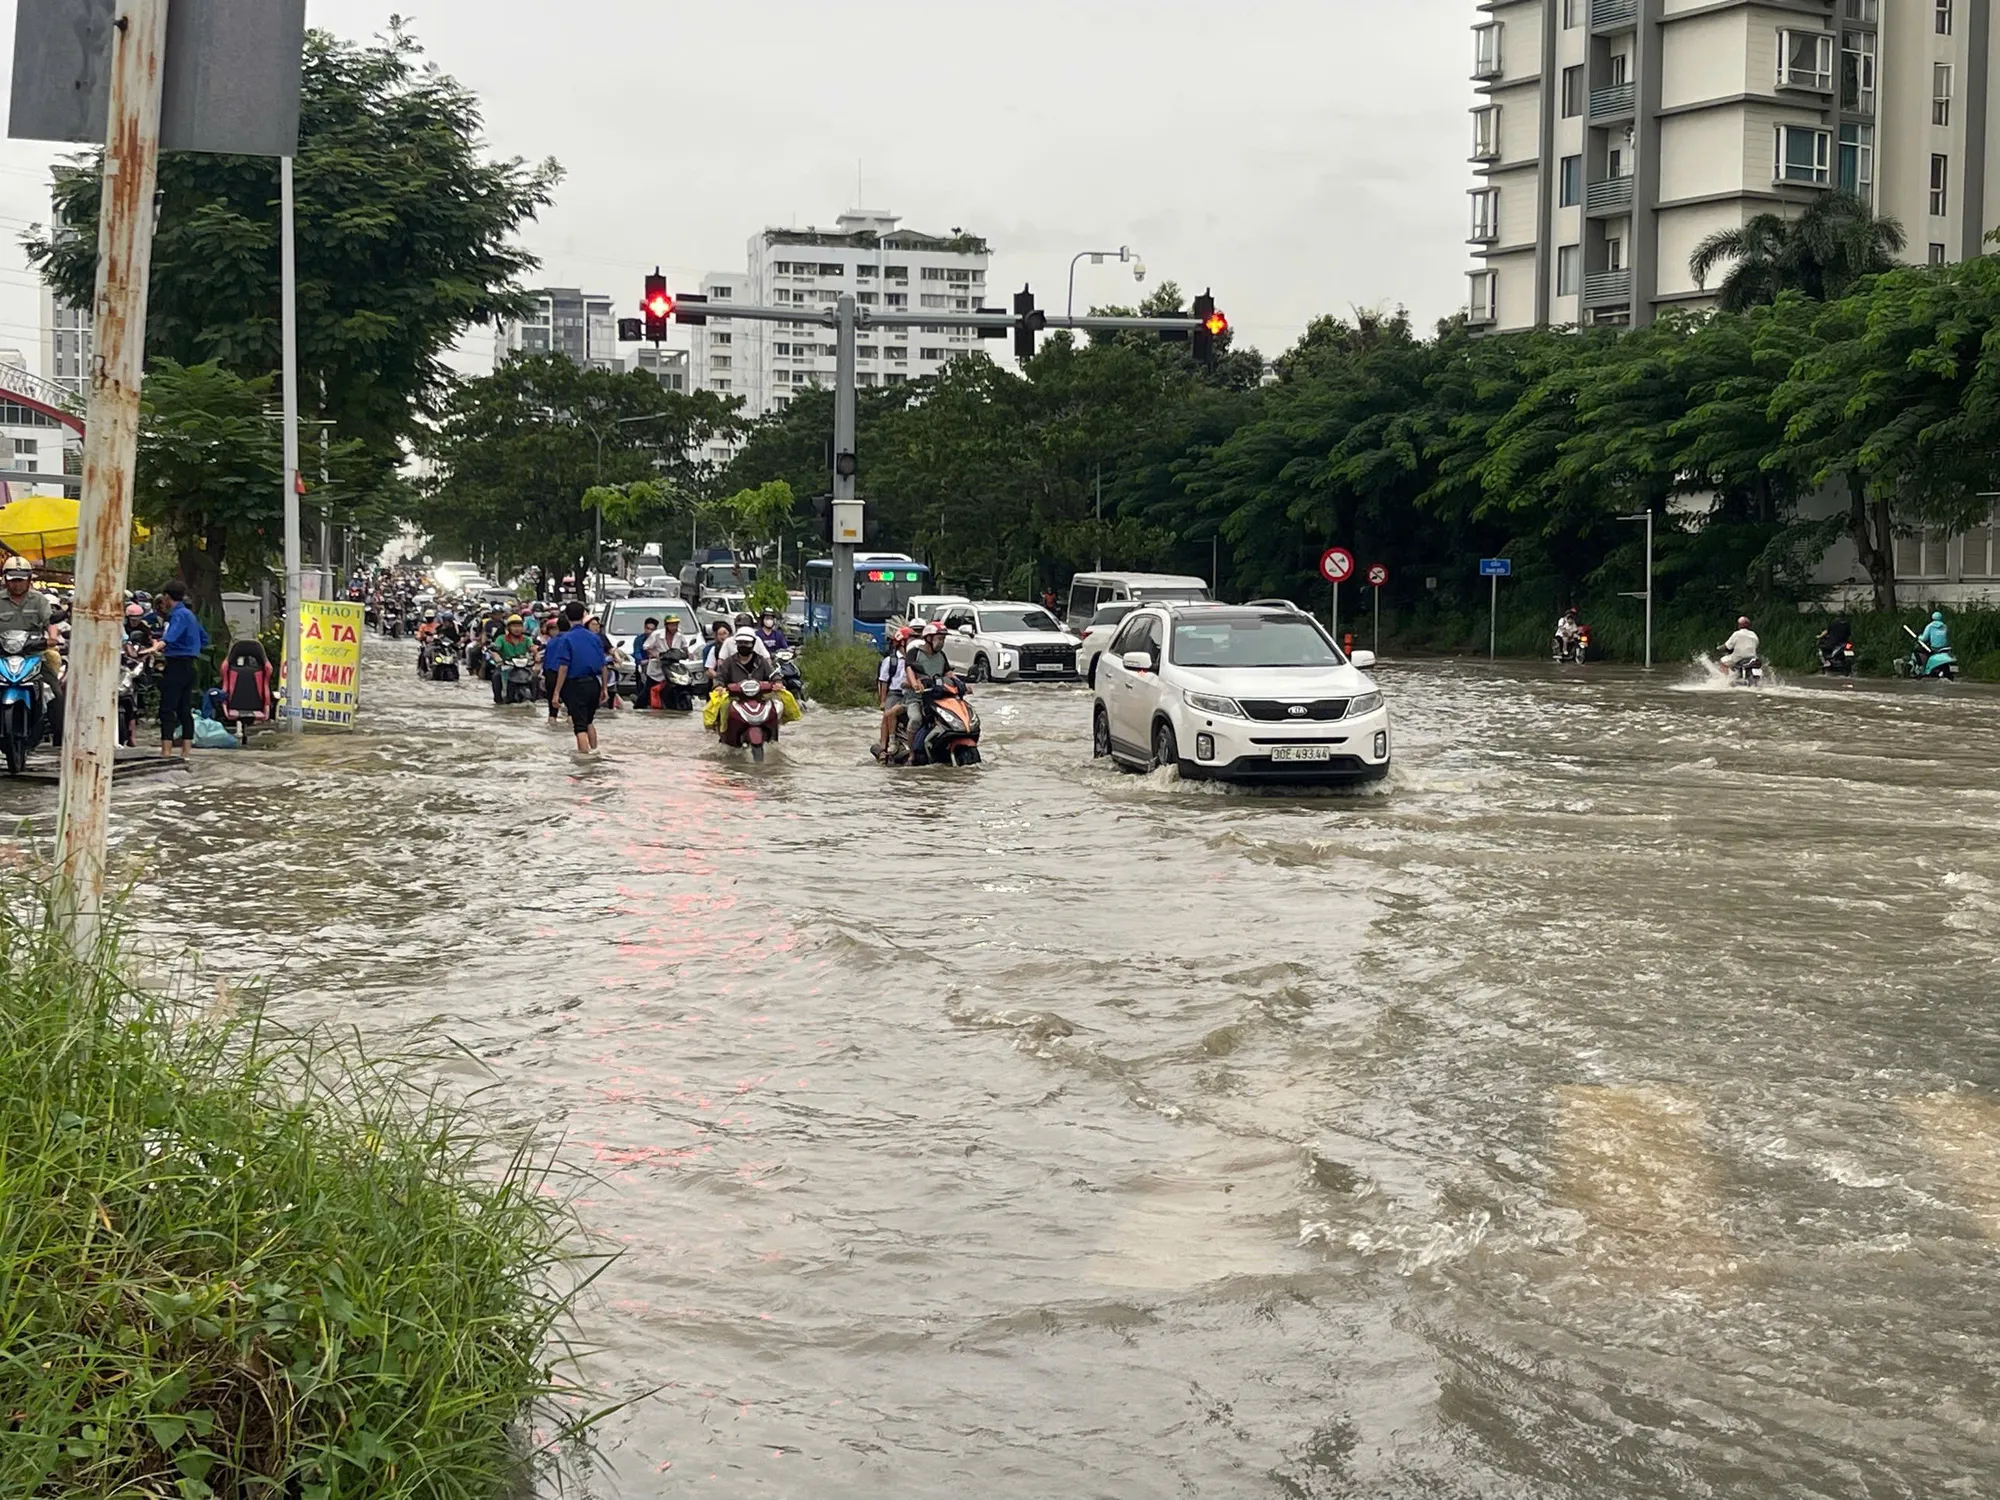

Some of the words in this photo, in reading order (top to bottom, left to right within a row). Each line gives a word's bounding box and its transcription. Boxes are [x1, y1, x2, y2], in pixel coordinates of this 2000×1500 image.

[331, 624, 357, 643] TA
[320, 663, 340, 685] TAM
[1290, 706, 1306, 715] KIA
